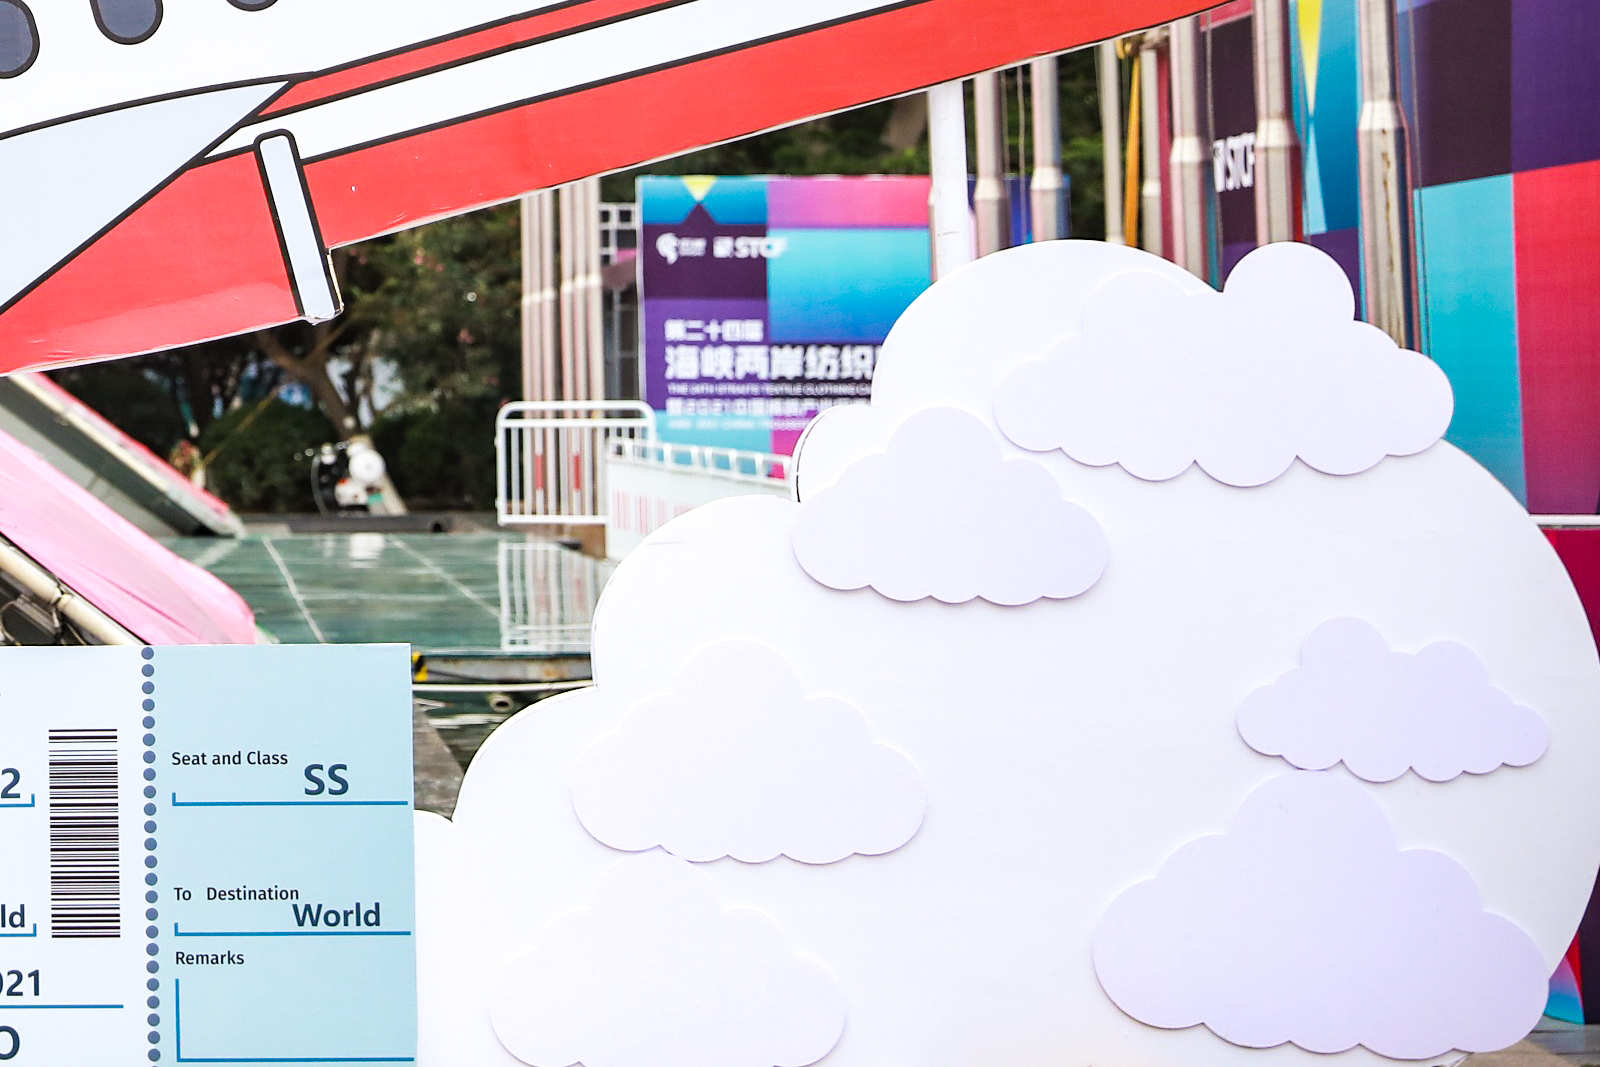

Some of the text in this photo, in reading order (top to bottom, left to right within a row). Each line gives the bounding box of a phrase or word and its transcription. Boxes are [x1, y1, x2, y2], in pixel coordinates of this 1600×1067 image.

[664, 345, 882, 380] 海峡两岸纺织
[171, 750, 290, 767] Seat and Class
[303, 763, 349, 796] SS
[173, 884, 300, 902] To Destination
[291, 901, 382, 928] World
[174, 949, 246, 966] Remarks
